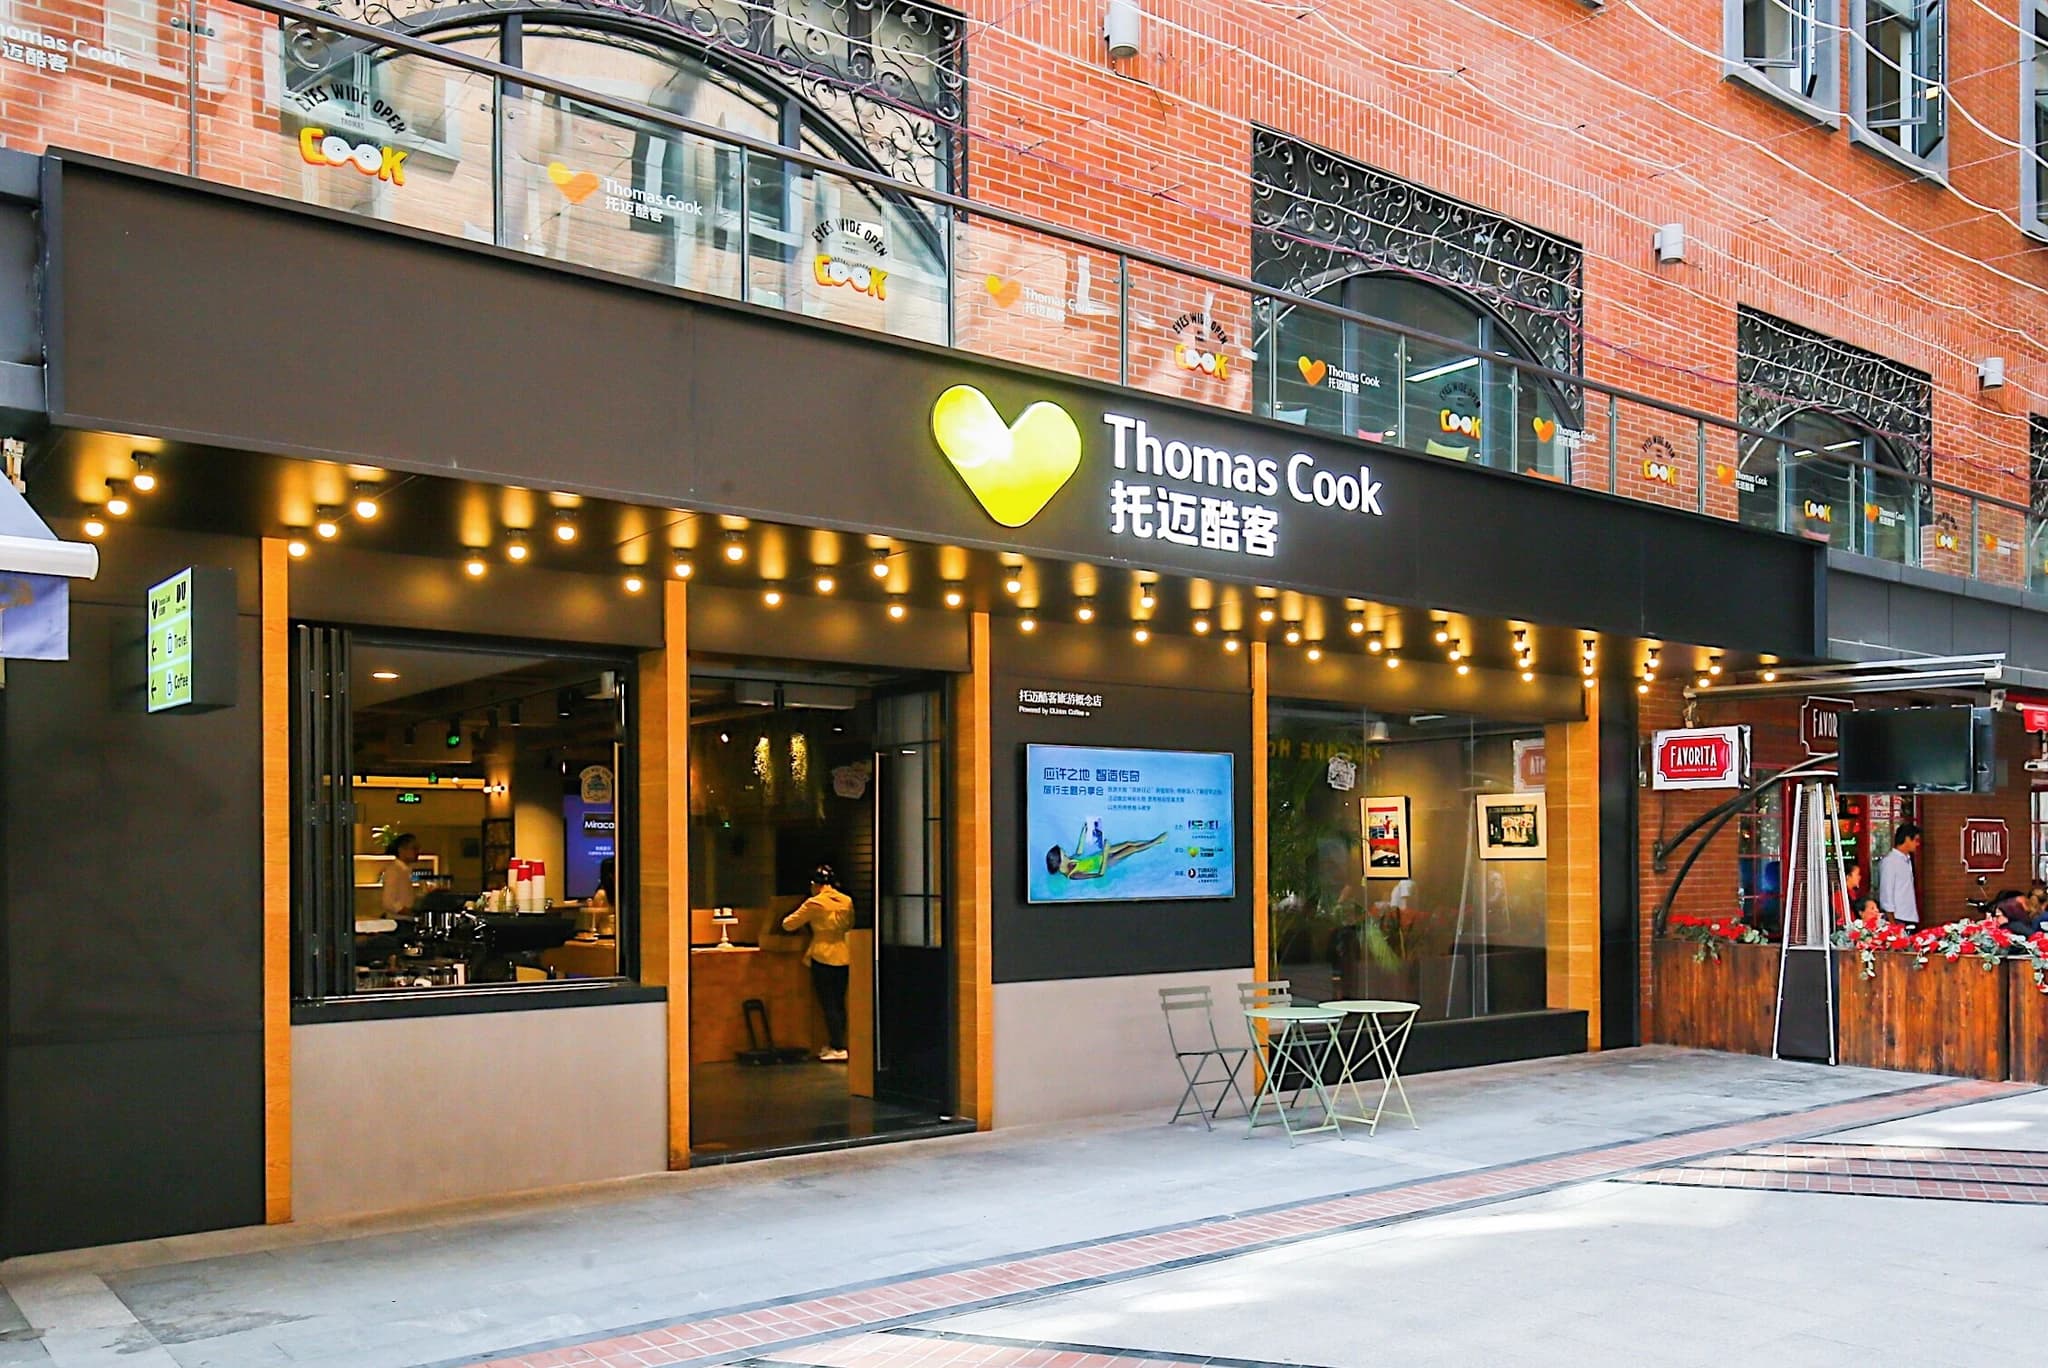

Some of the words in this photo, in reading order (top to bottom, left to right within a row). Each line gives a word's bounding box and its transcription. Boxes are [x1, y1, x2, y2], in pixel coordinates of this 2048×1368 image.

[72, 39, 130, 68] Cook
[295, 86, 329, 112] EYES
[331, 84, 369, 106] WIDE
[373, 99, 407, 134] OPEN
[299, 127, 408, 187] COOK
[600, 196, 664, 223] 托迈酷客
[602, 177, 663, 205] Thomas
[666, 194, 703, 216] Cook
[811, 220, 834, 244] EYES
[835, 218, 861, 235] WIDE
[864, 229, 888, 256] OPEN
[813, 254, 888, 301] COOK
[1172, 314, 1190, 334] EYES
[1210, 320, 1228, 345] OPEN
[1174, 343, 1229, 382] COOK
[1327, 364, 1360, 382] Thomas
[1360, 372, 1381, 388] Cook
[1103, 412, 1279, 497] Thomas
[1287, 452, 1385, 517] Cook
[1110, 479, 1280, 558] 托迈酷客
[1670, 743, 1717, 768] FAVORITA
[1971, 830, 2001, 857] FAVORITA
